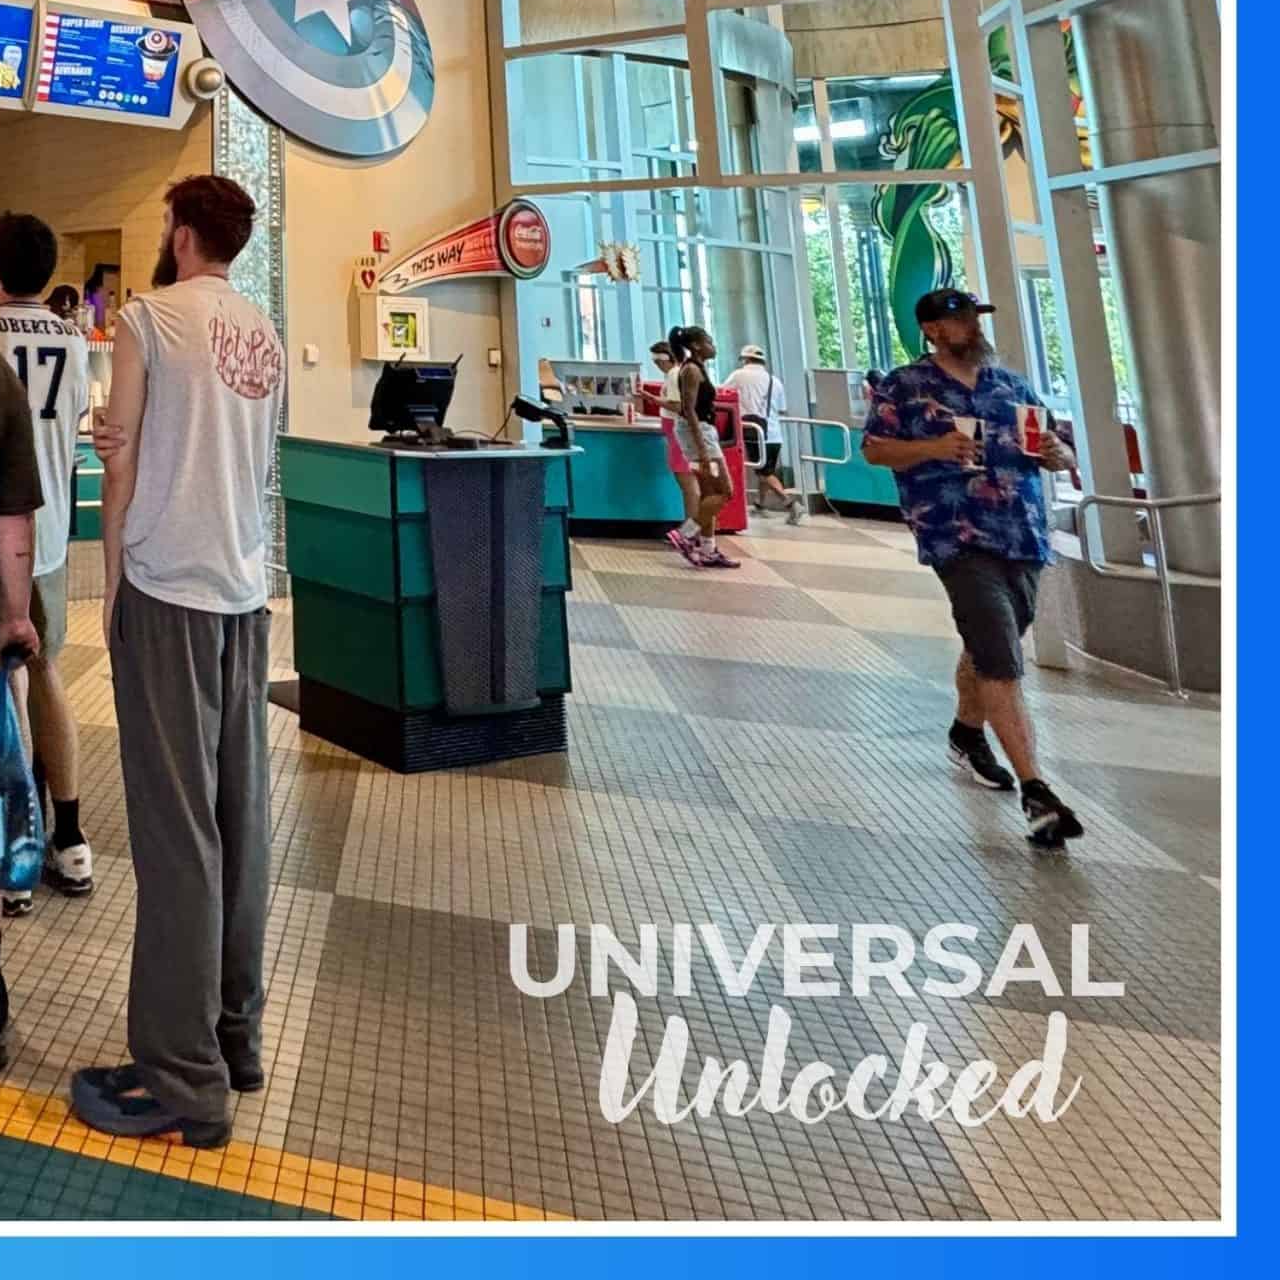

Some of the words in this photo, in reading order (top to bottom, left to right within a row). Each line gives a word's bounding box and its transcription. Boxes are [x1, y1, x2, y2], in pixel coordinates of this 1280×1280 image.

[411, 255, 435, 277] THIS
[436, 241, 466, 266] WAY
[13, 345, 68, 419] 17
